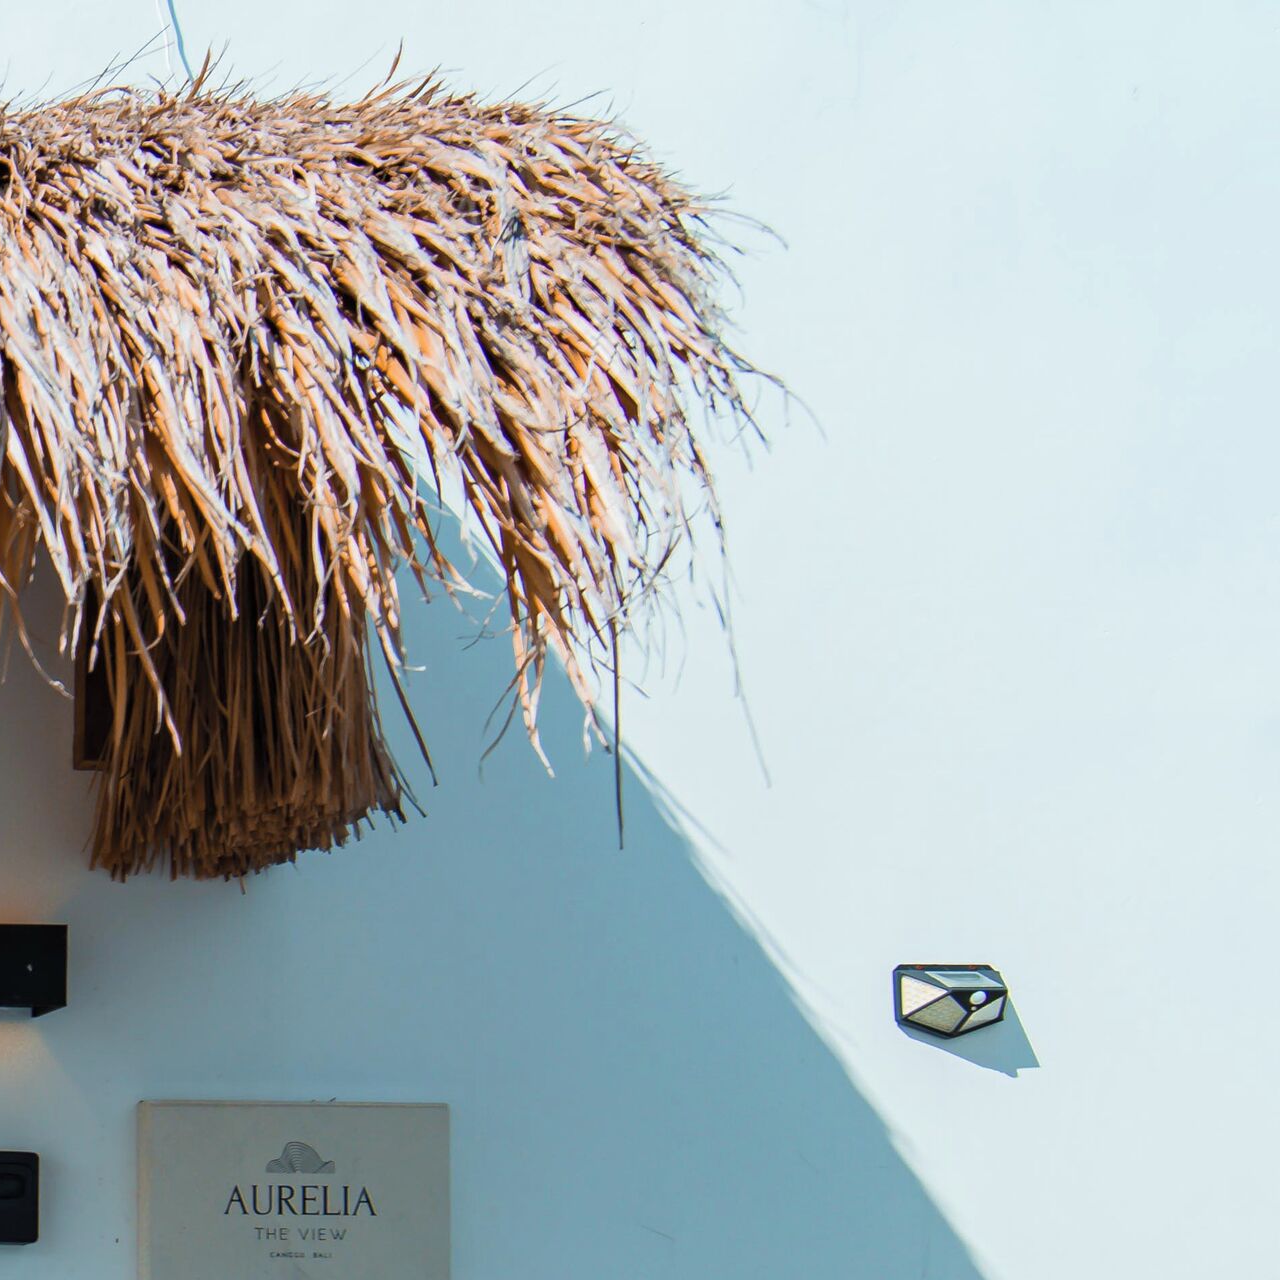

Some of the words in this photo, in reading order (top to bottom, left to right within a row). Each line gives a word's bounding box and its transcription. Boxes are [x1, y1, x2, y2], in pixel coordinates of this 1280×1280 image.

[223, 1184, 378, 1217] AURELIA
[254, 1227, 289, 1241] THE
[297, 1227, 347, 1241] VIEW
